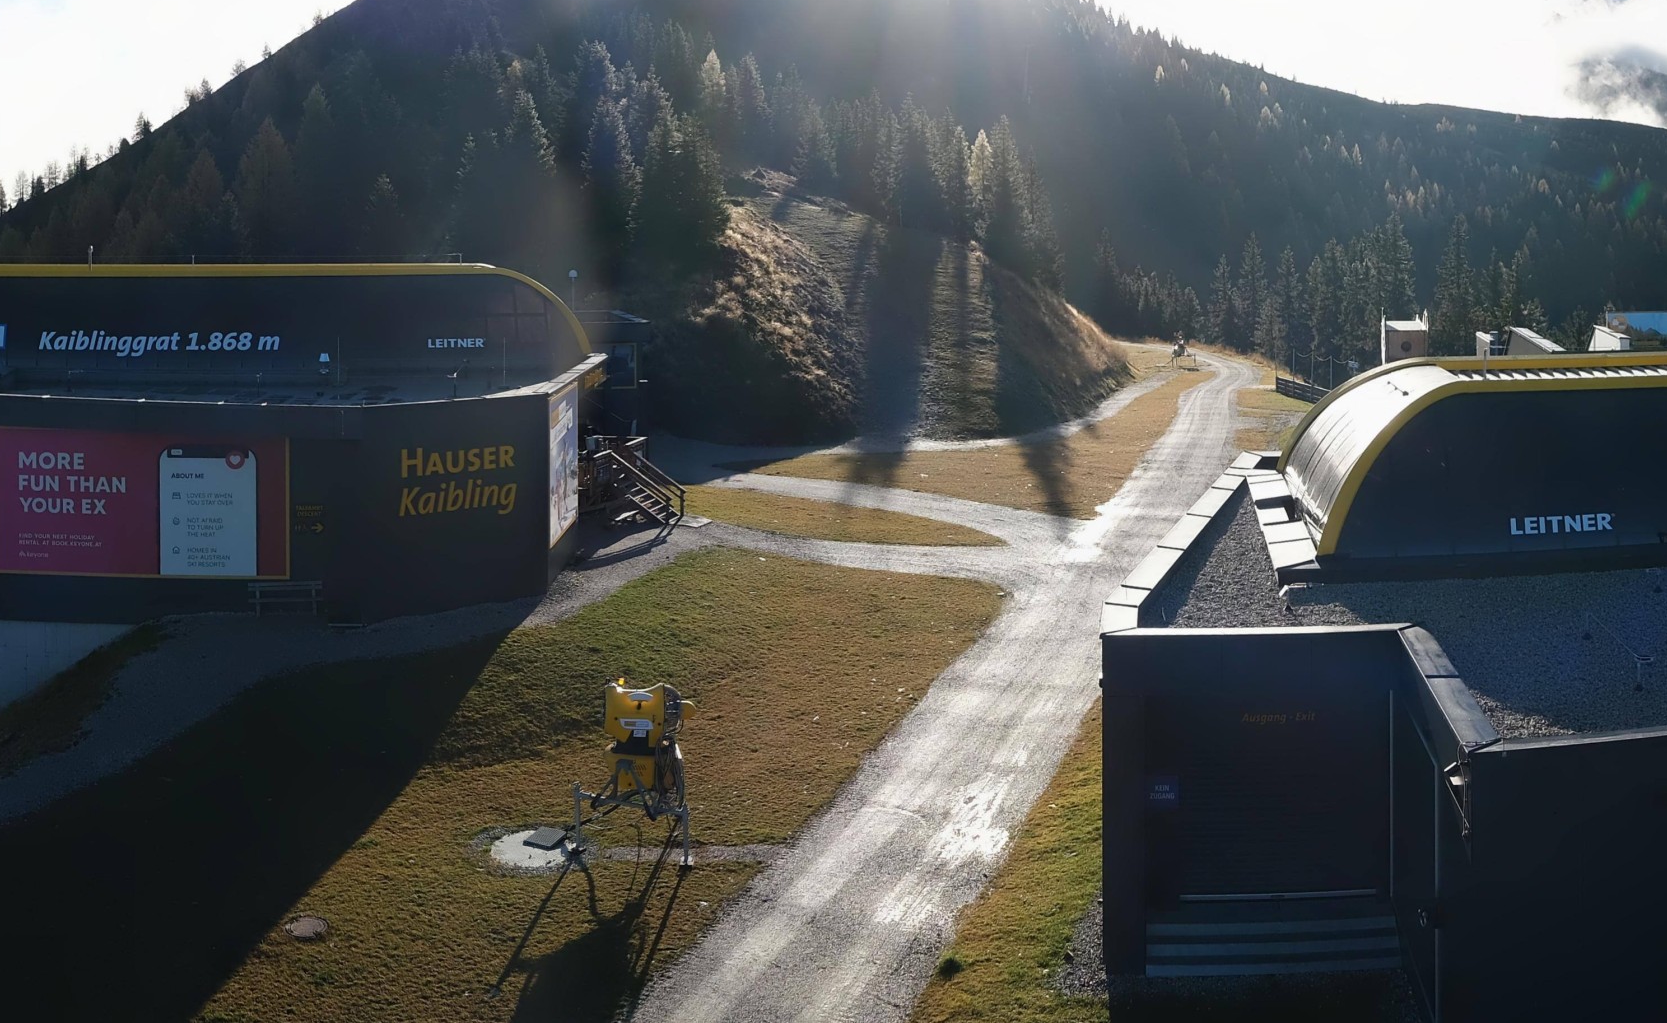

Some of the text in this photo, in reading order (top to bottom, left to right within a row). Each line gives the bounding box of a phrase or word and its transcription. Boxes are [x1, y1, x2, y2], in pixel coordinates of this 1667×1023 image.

[38, 330, 280, 357] Kaiblinggrat 1.868 m
[427, 337, 485, 348] LEITNER
[18, 451, 85, 470] MORE
[401, 445, 516, 478] HAUSER
[18, 474, 126, 493] FUN THAN
[19, 496, 107, 515] YOUR EX
[399, 478, 517, 516] Kaibling
[1241, 712, 1287, 724] Ausgang
[1295, 711, 1316, 721] Exit
[1149, 792, 1175, 800] ZUGANG
[1154, 784, 1170, 792] KEIN
